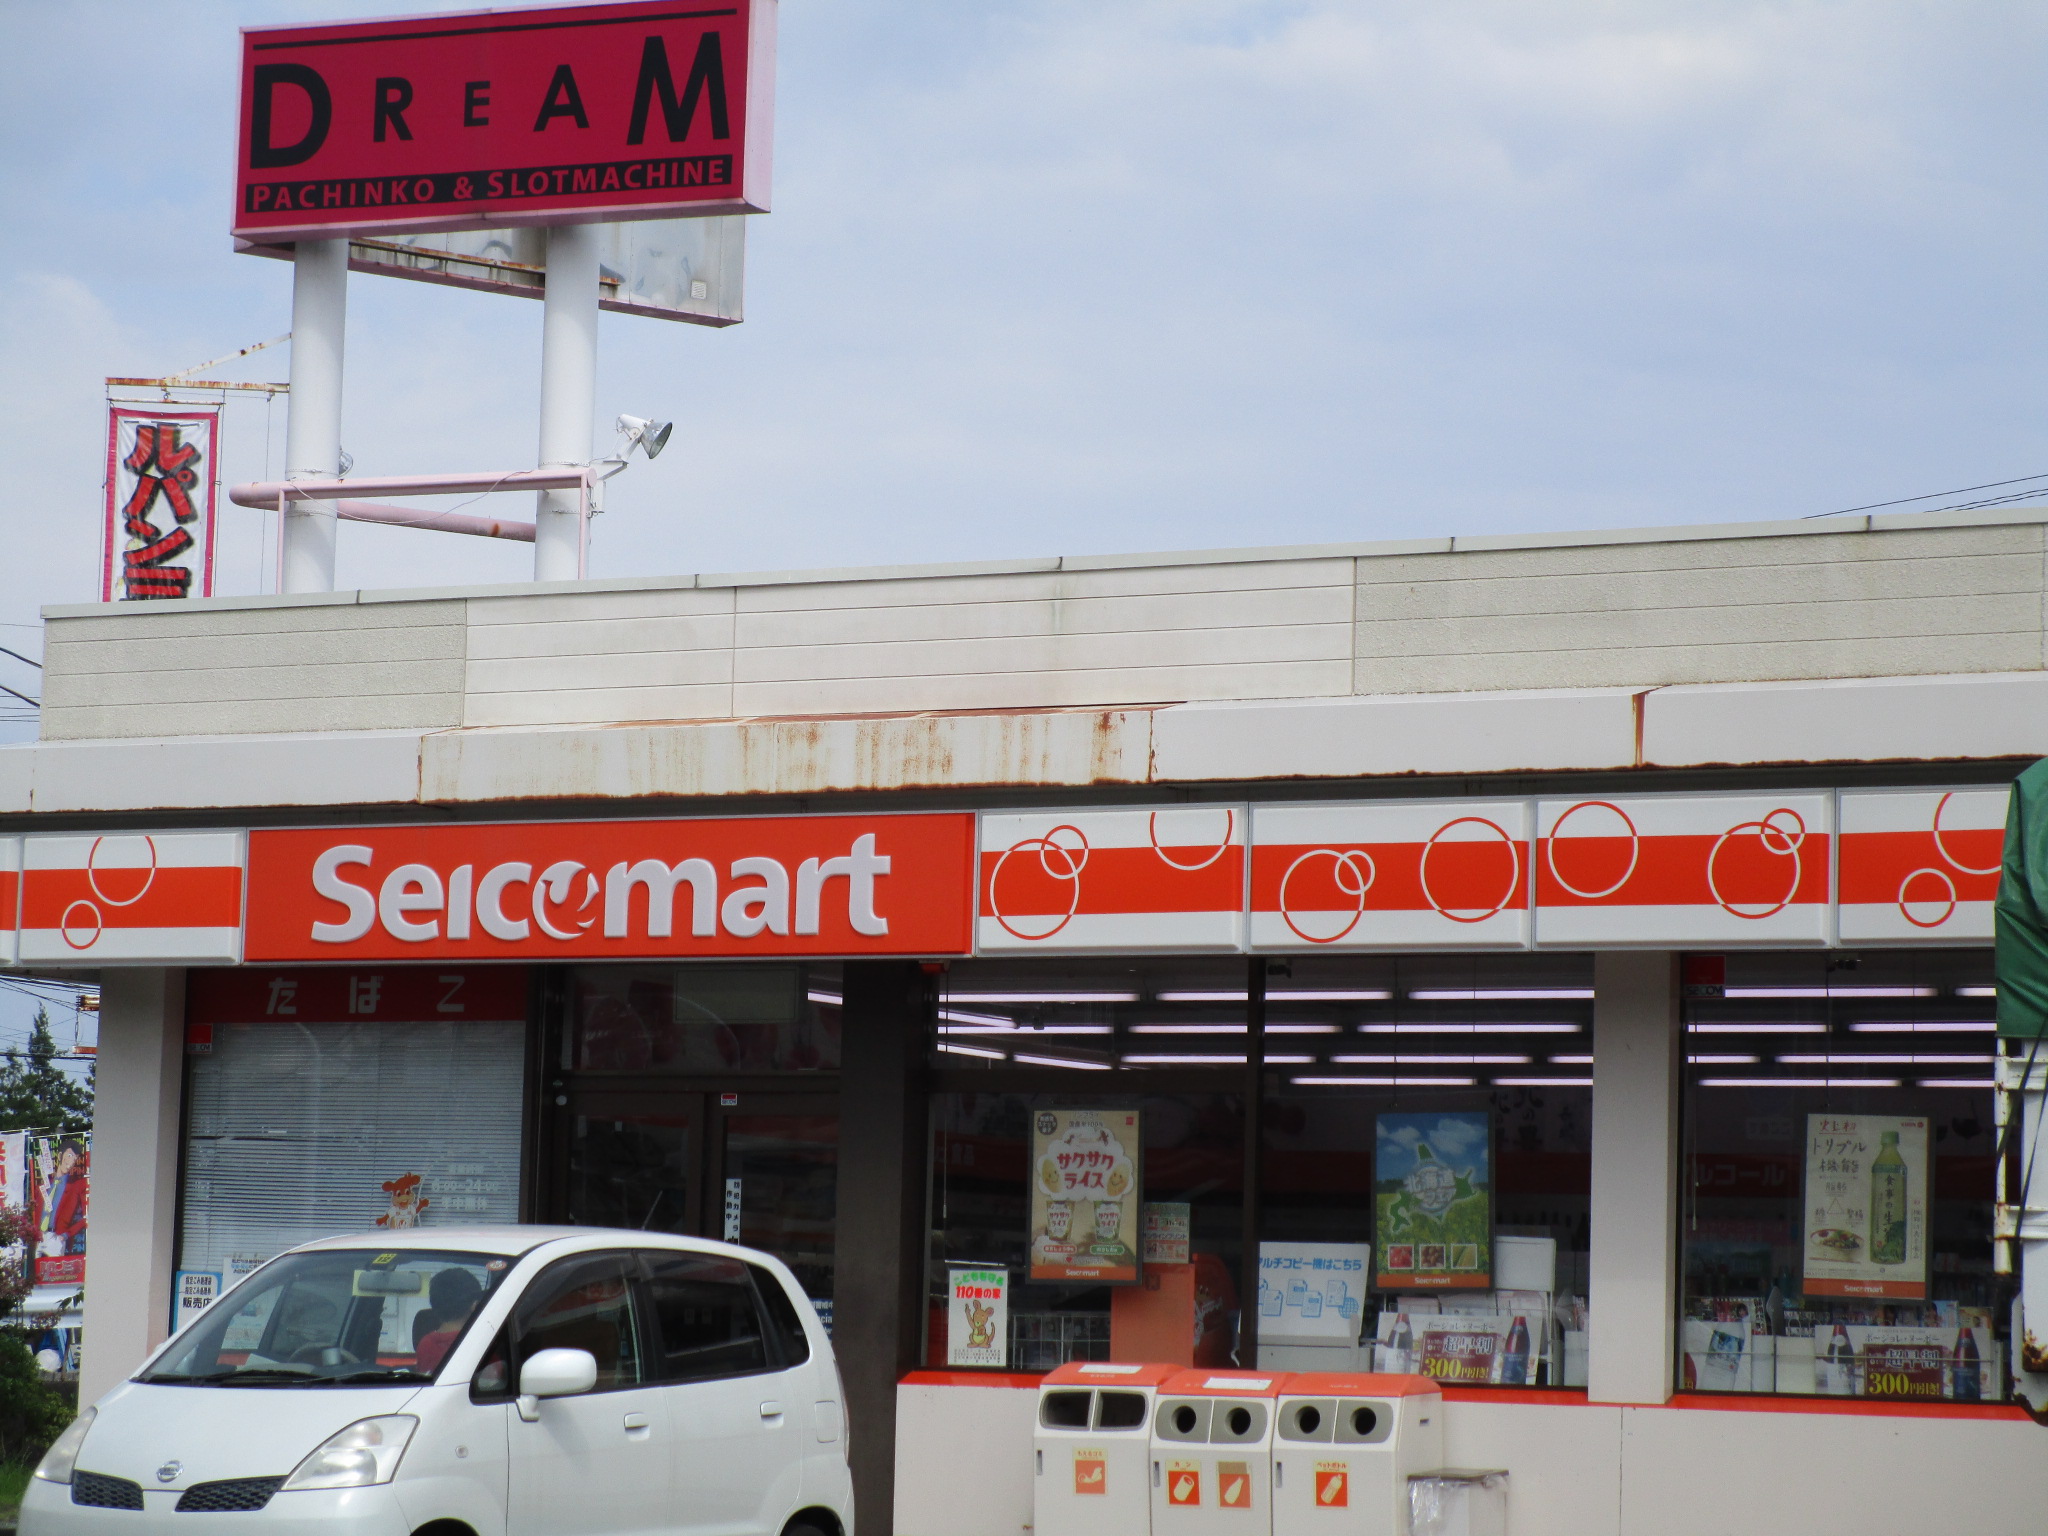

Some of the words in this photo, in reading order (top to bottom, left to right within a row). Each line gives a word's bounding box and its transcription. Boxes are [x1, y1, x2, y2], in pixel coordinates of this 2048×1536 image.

[250, 31, 731, 169] DREAM
[253, 178, 435, 210] PACHINKO
[453, 176, 474, 199] &
[487, 158, 725, 197] SLOTMACHINE
[310, 833, 892, 942] Seicomart
[265, 975, 465, 1015] たばこ
[1057, 1150, 1114, 1170] サクサク
[1813, 1138, 1867, 1155] トリプル
[1064, 1171, 1105, 1189] ライス
[1688, 1162, 1786, 1186] ルコール
